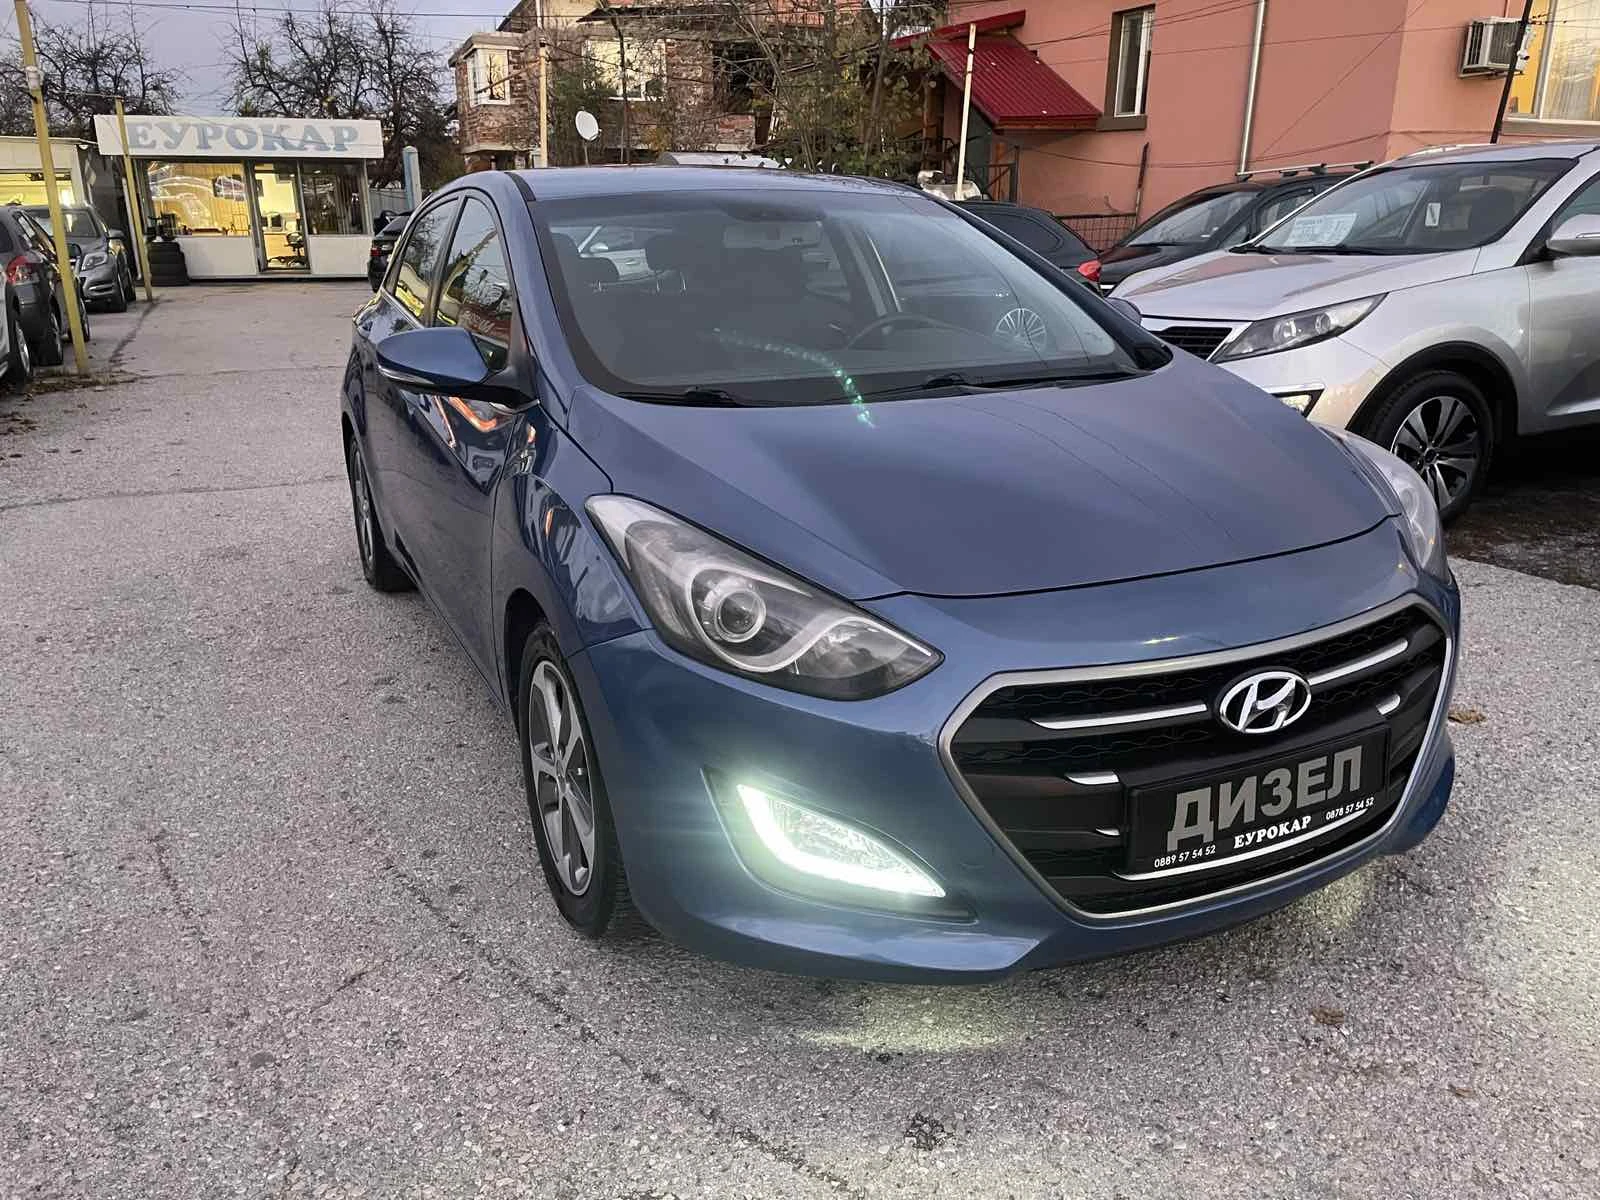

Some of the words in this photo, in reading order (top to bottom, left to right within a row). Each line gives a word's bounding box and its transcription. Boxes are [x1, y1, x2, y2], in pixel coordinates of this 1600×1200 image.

[127, 121, 359, 152] ЕУРОКАР
[1167, 745, 1362, 851] ДИЗЕЛ
[1325, 807, 1344, 820] 0878
[1345, 803, 1355, 814] 57
[1355, 800, 1364, 811] 54
[1365, 796, 1375, 808] 52
[1233, 815, 1312, 849] ЕУРОКАР
[1154, 854, 1177, 868] 0889
[1178, 851, 1190, 862] 57
[1191, 847, 1203, 859] 54
[1204, 844, 1216, 856] 52
